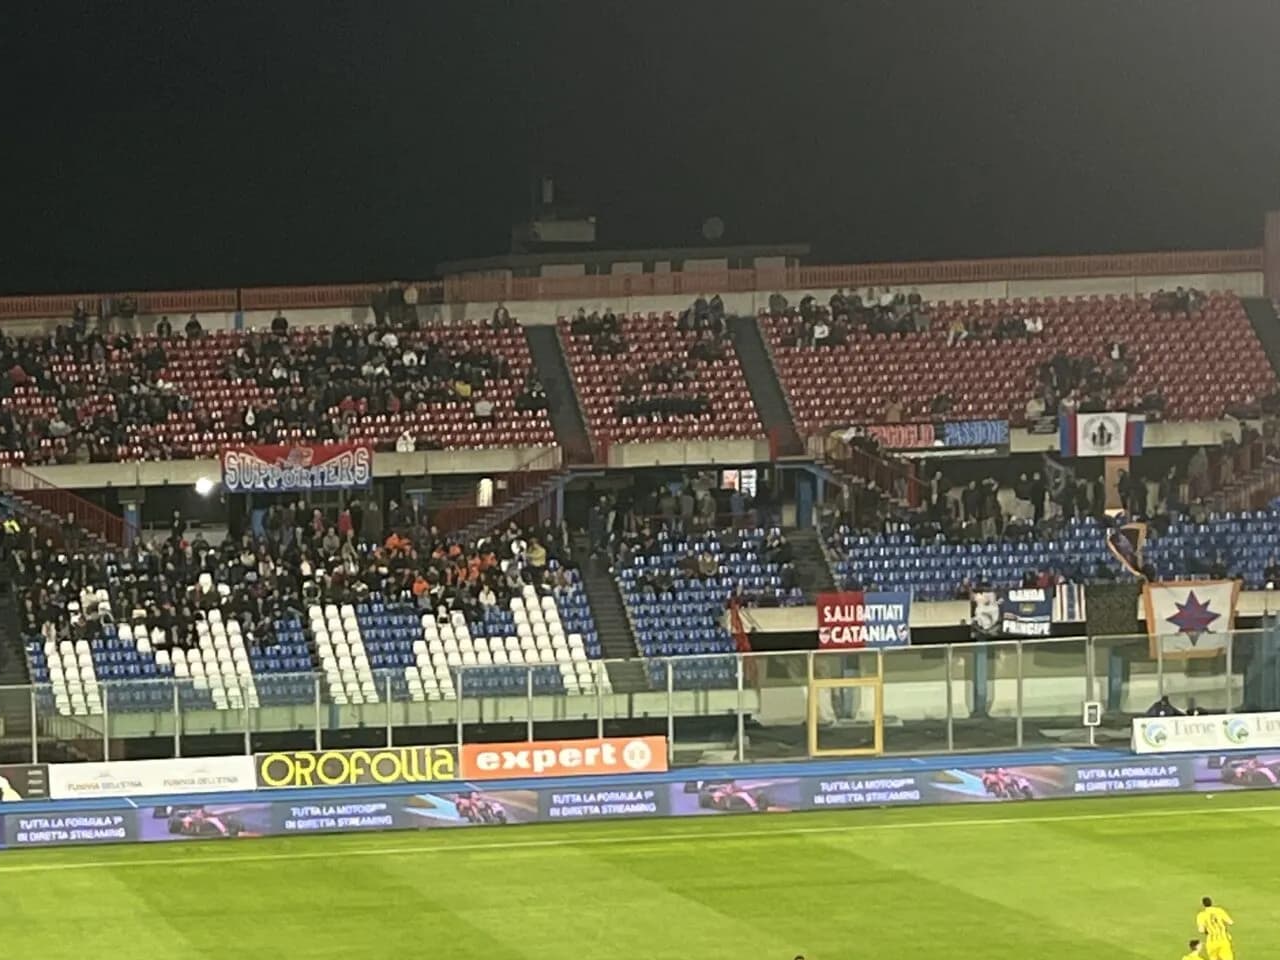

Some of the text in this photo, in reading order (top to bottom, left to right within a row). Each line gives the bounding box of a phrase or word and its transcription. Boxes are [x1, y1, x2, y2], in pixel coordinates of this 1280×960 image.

[225, 447, 370, 489] SUPPORTERS
[856, 604, 903, 621] BATTIATI
[831, 624, 897, 643] CATANIA
[477, 743, 617, 772] expert
[1108, 768, 1120, 778] LA
[851, 780, 864, 790] LA
[583, 793, 596, 803] LA
[323, 806, 335, 815] LA
[51, 818, 64, 828] LA
